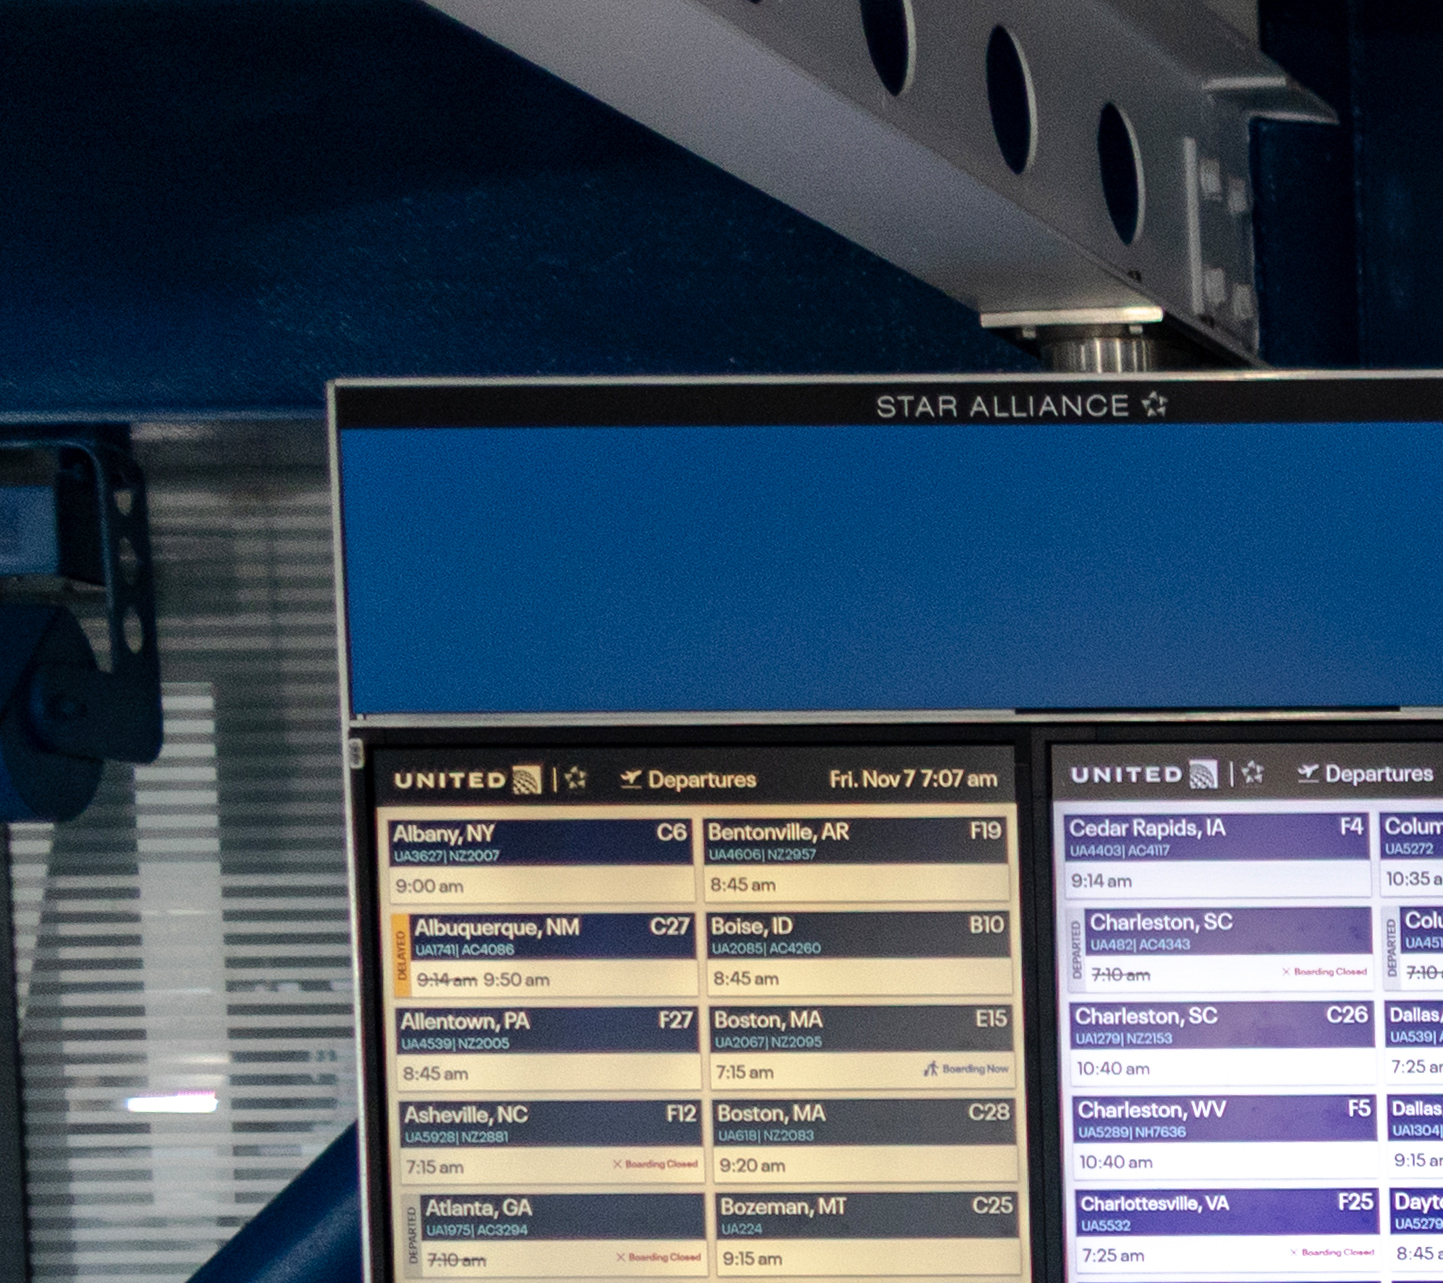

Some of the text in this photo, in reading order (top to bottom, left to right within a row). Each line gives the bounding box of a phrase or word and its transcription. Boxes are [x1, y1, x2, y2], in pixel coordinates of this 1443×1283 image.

[877, 394, 1128, 417] STAR ALLIANCE
[1072, 767, 1181, 782] UNITED
[1326, 764, 1433, 786] Departures
[1386, 843, 1433, 854] UA5272
[415, 917, 690, 939] Albuquerque, NM C27
[722, 1223, 762, 1234] UA224
